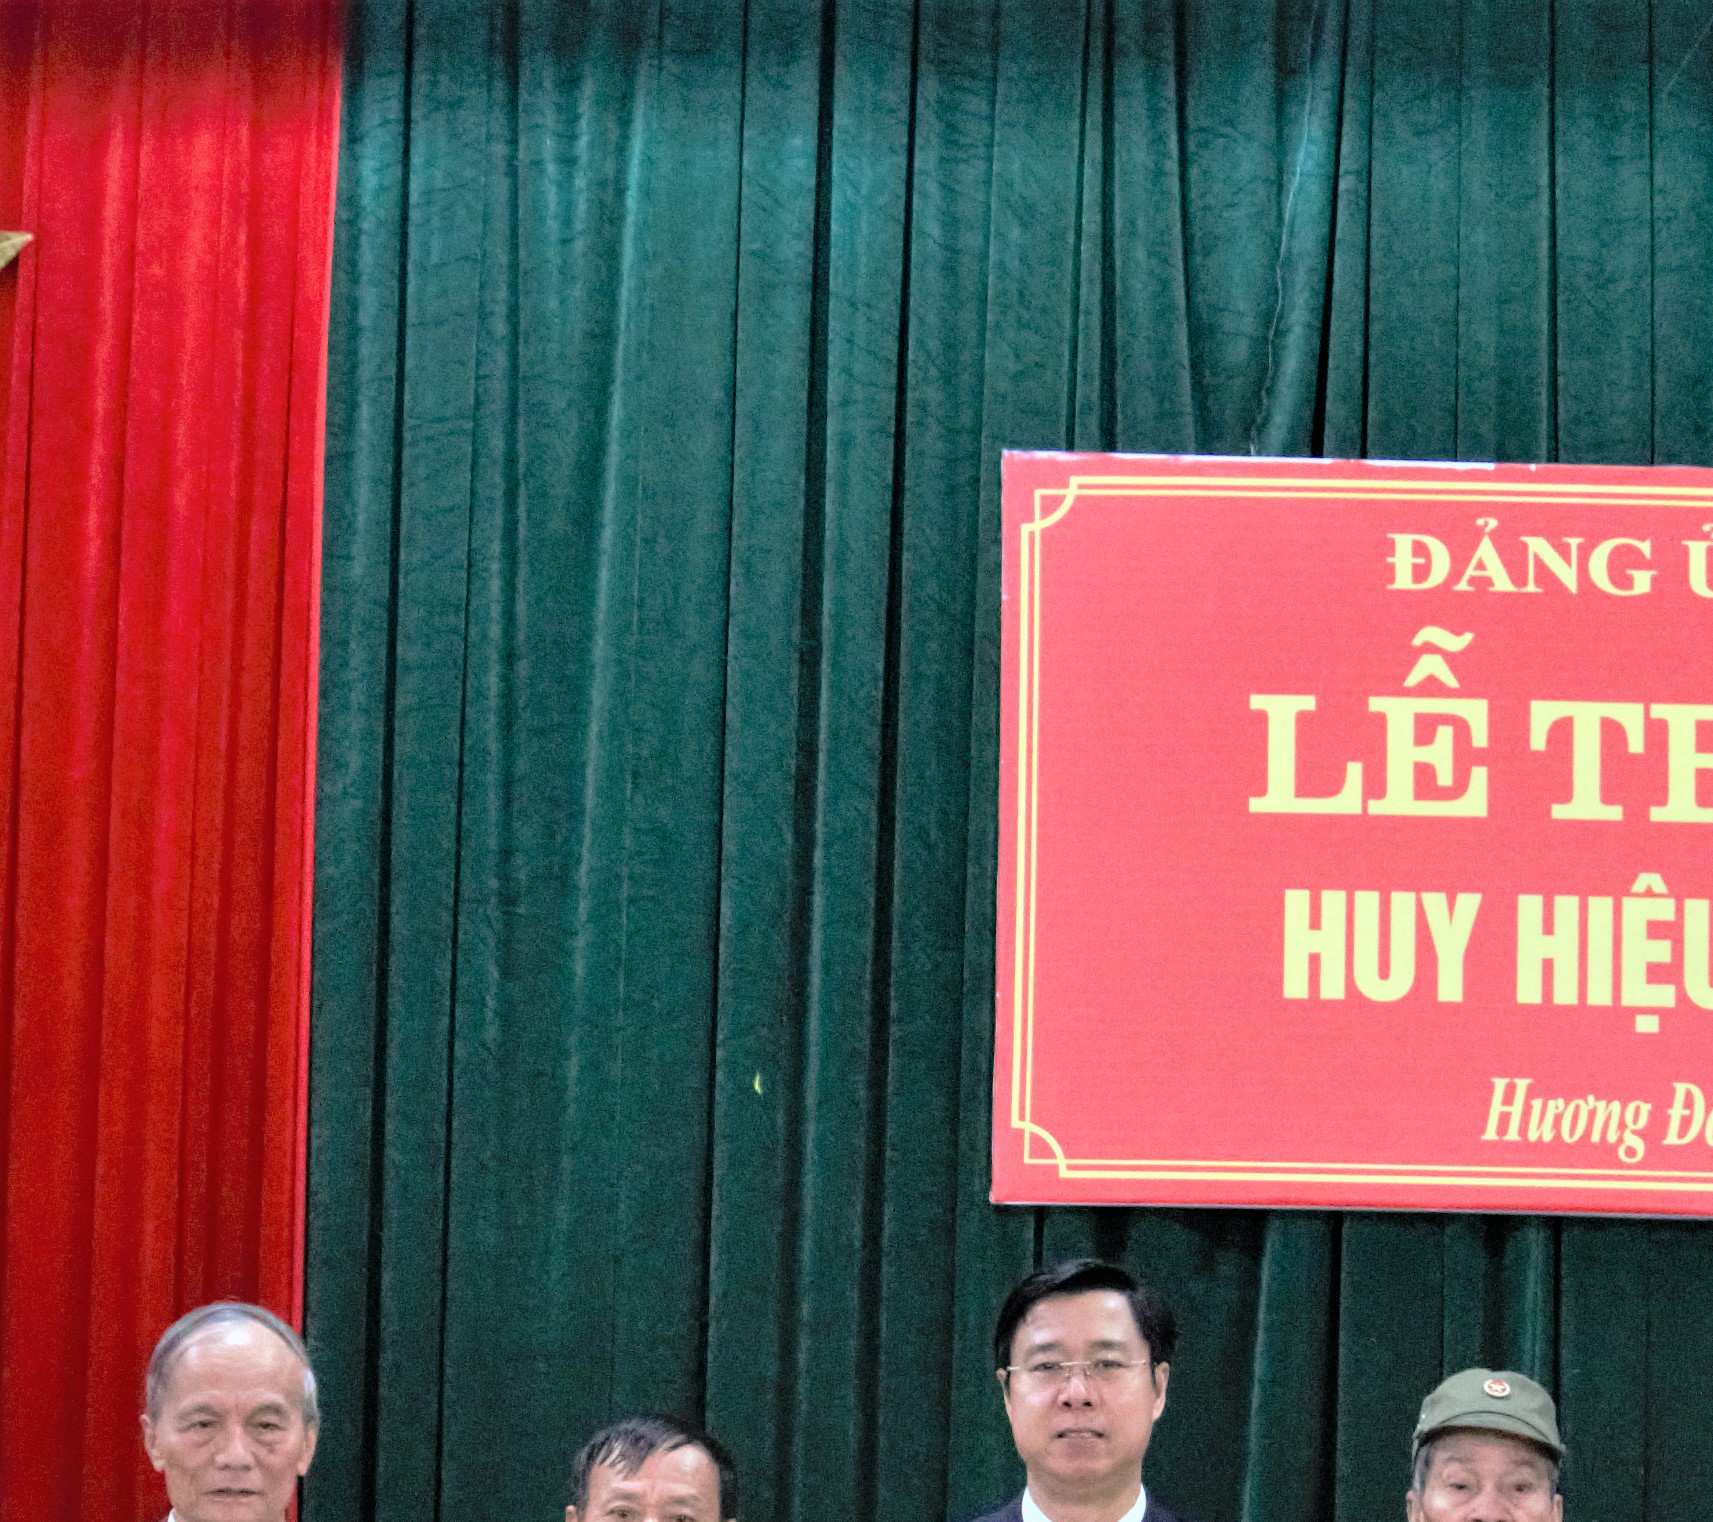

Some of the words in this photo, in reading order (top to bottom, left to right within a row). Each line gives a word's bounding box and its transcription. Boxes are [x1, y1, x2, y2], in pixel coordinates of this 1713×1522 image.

[1387, 517, 1656, 596] ĐẢNG
[1249, 626, 1488, 817] LỄ
[1283, 889, 1482, 1002] HUY
[1481, 1077, 1652, 1157] Hương
